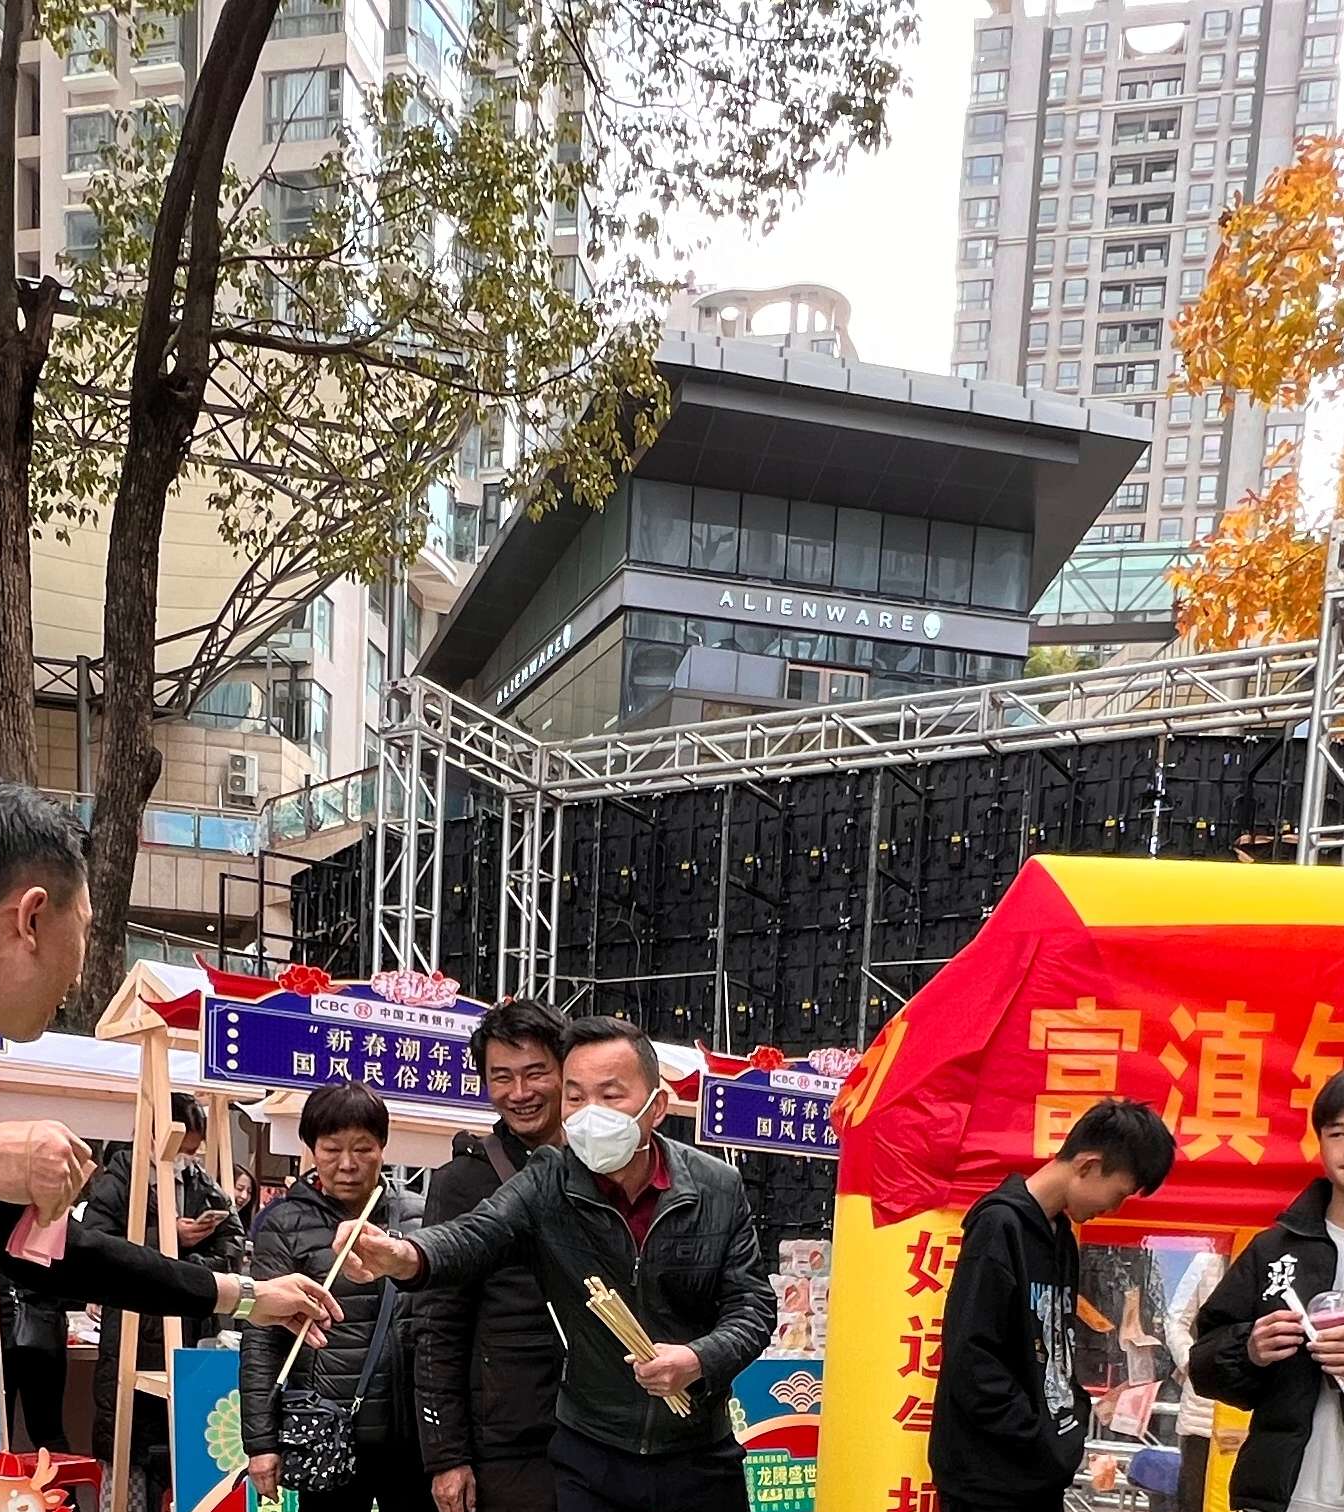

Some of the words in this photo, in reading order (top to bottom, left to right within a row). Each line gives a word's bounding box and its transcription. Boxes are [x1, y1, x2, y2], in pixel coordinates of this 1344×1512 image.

[719, 590, 913, 633] ALIENWARE
[496, 637, 562, 706] ALIENWARE
[315, 998, 350, 1014] ICBC
[380, 1007, 456, 1028] 中国工商银行
[292, 1051, 482, 1097] 国风民俗游园
